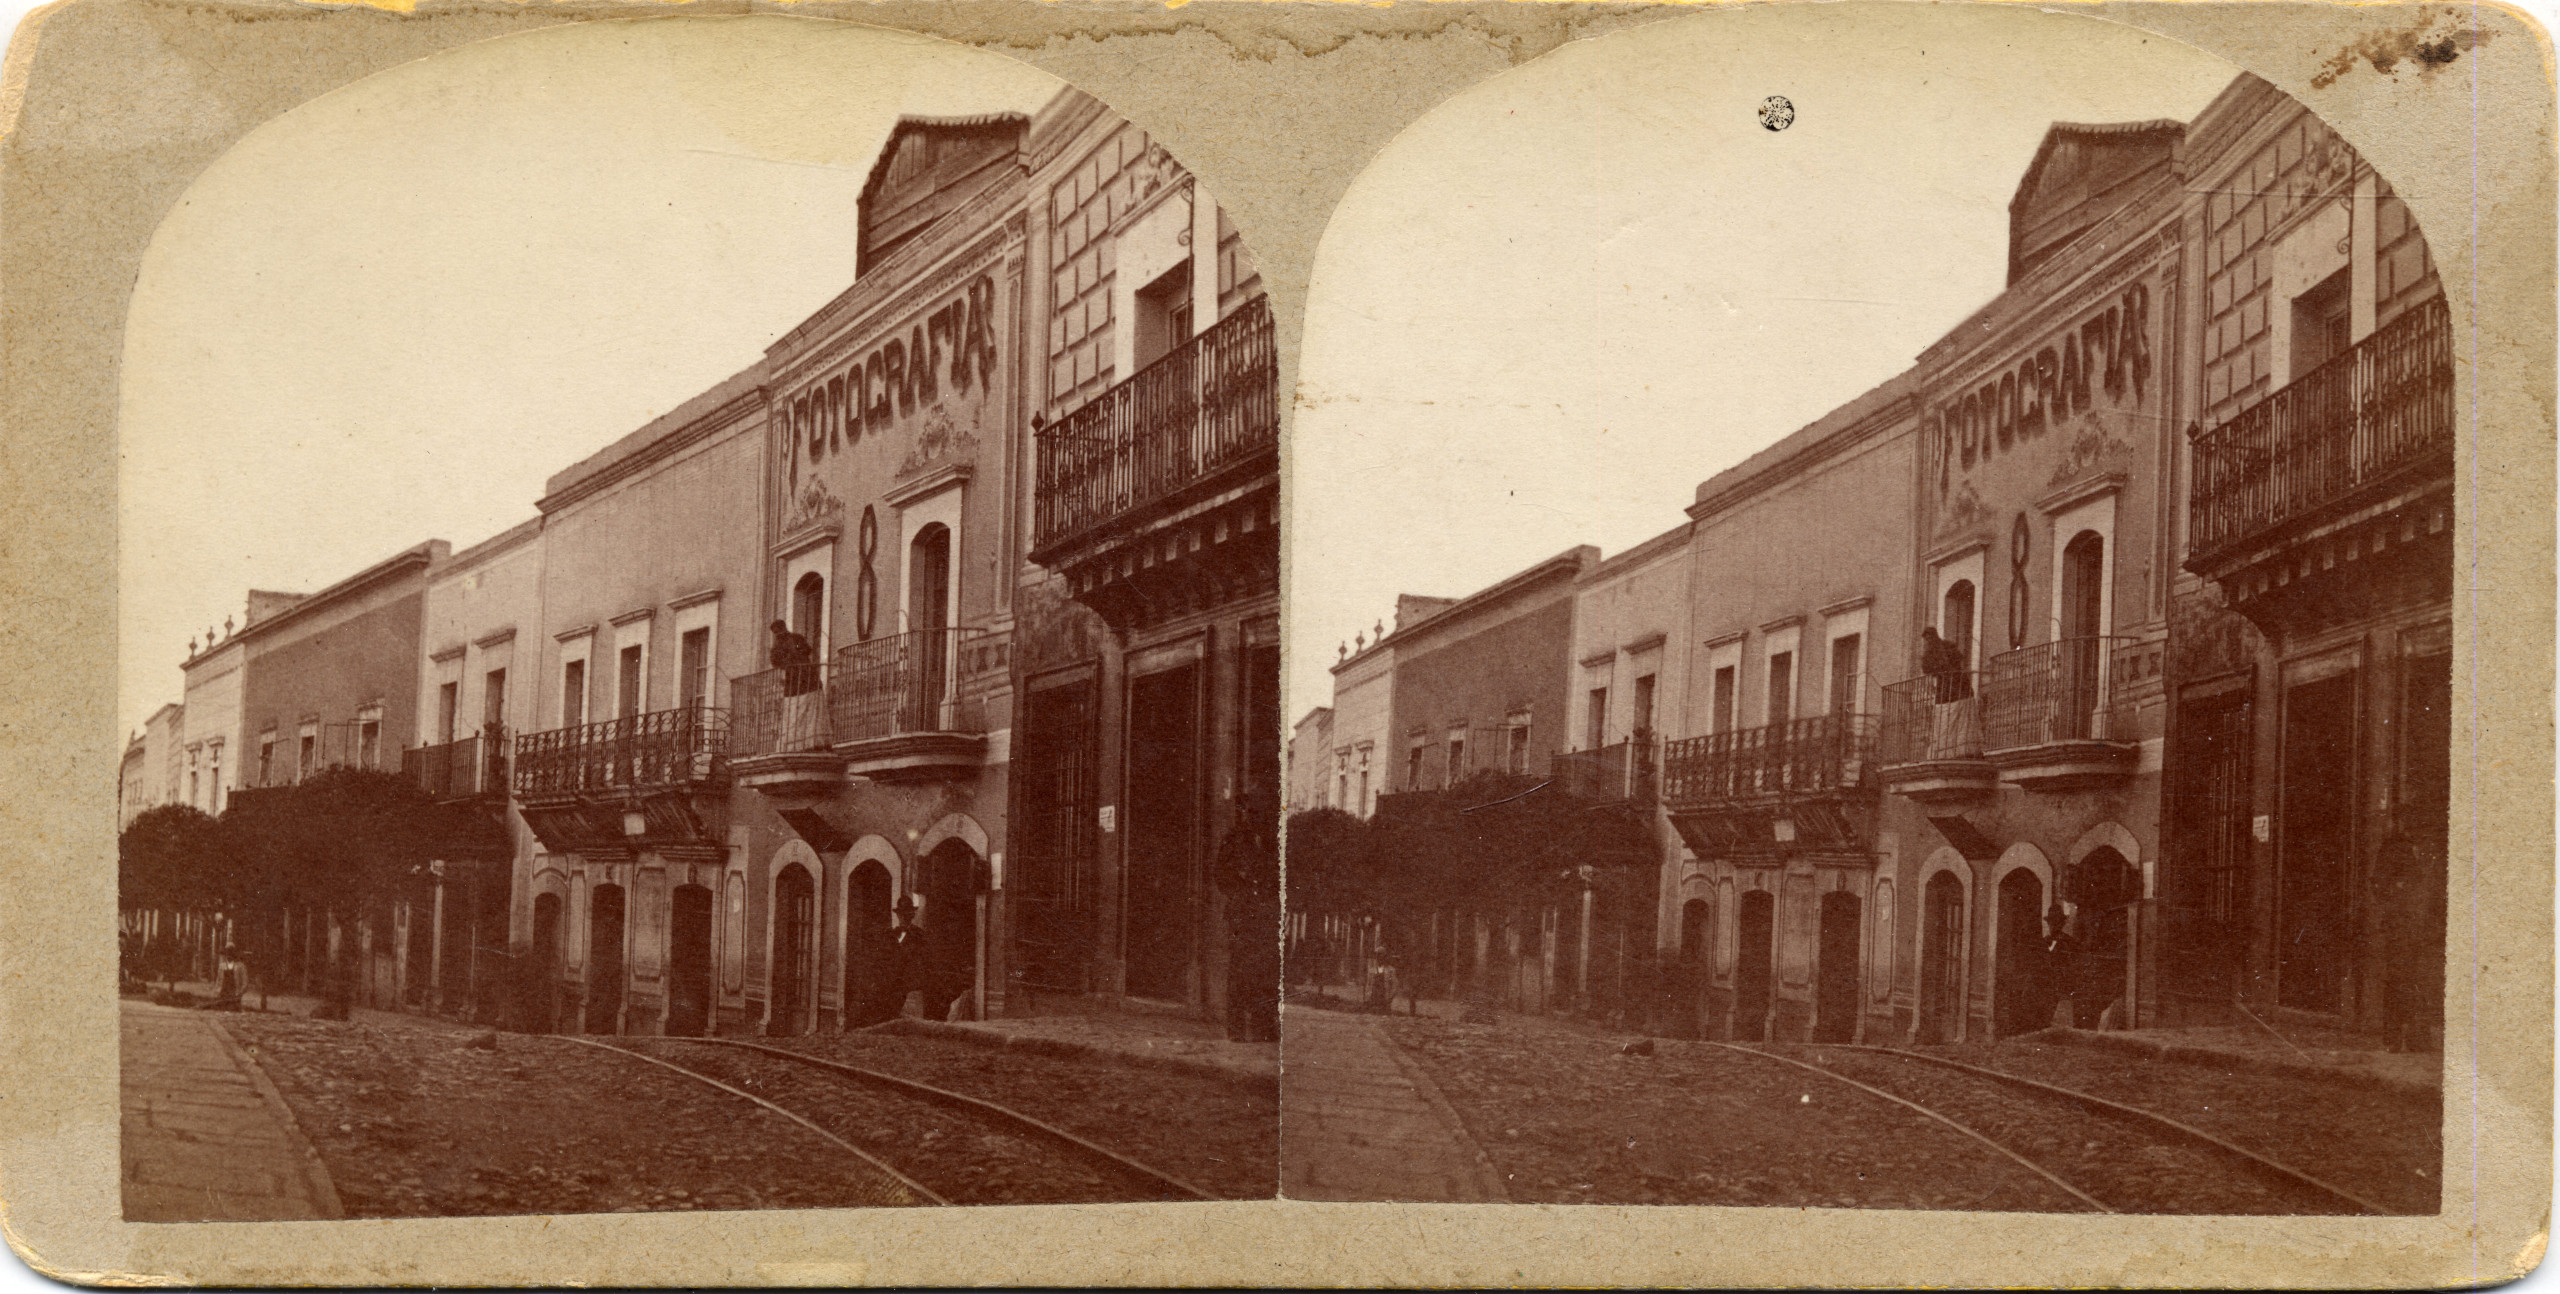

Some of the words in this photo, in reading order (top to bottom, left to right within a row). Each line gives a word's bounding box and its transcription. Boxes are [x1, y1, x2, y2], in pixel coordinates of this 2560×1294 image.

[784, 274, 997, 504] FOTOGRAFIA
[857, 503, 877, 641] 8
[2008, 510, 2029, 649] 8
